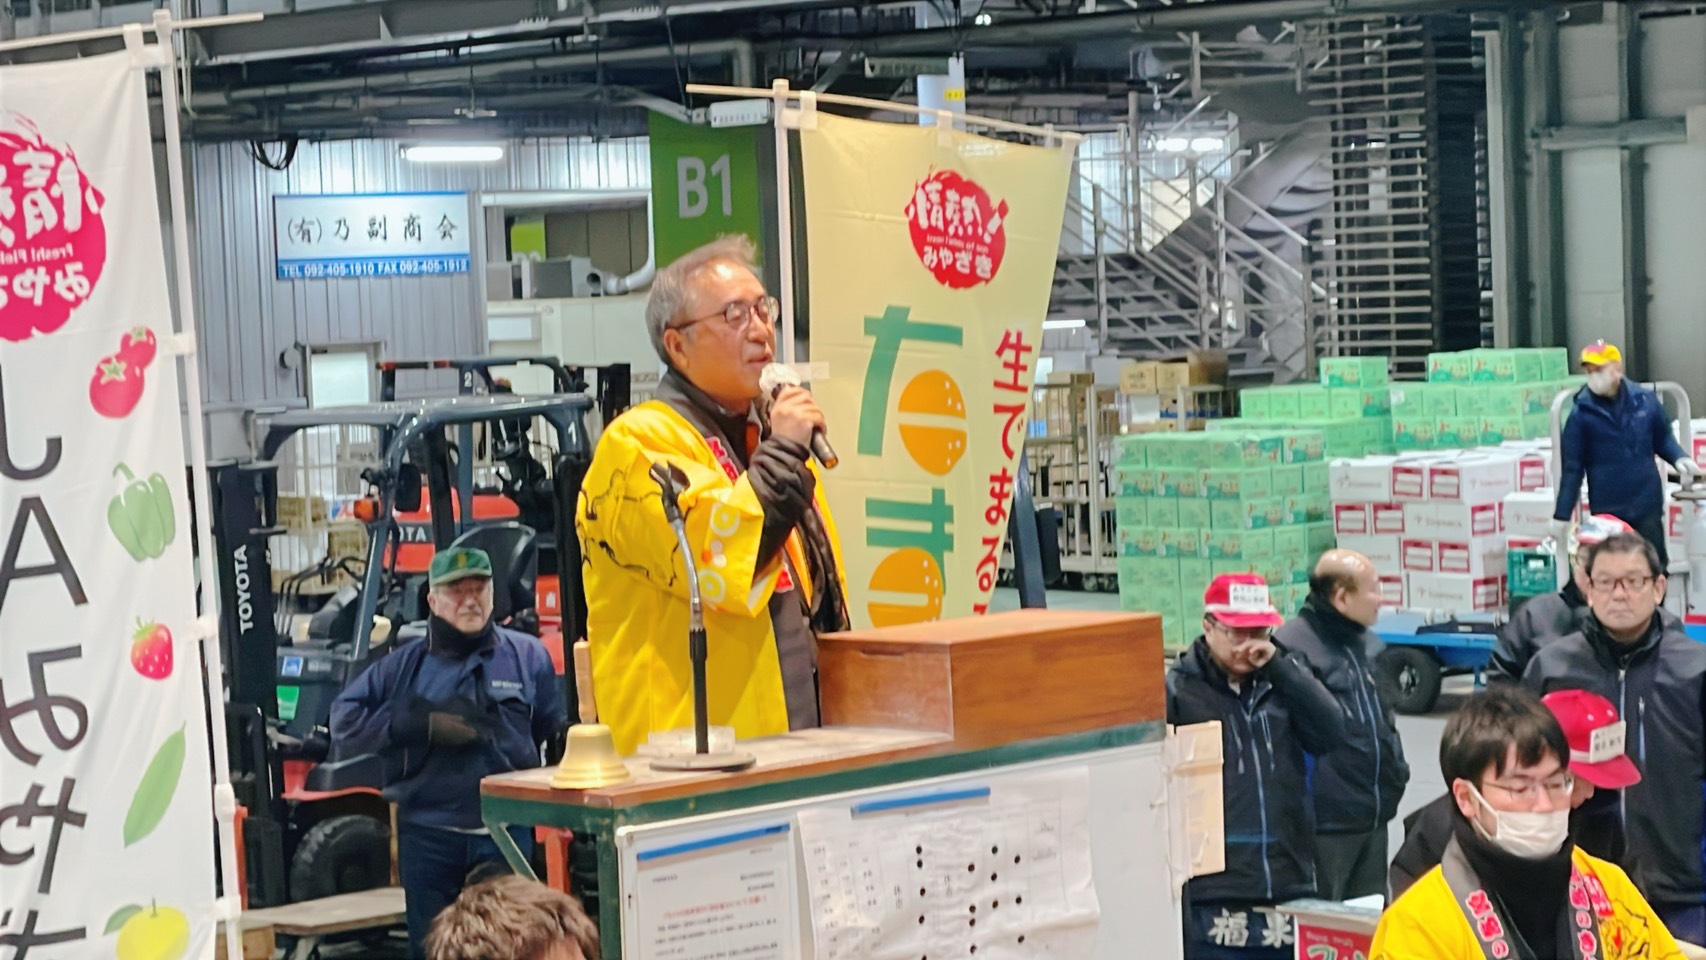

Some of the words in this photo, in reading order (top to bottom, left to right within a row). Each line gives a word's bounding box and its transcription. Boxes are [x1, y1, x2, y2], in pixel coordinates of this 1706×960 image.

[677, 153, 732, 219] B1
[282, 265, 302, 278] TEL
[377, 261, 398, 275] FAX
[922, 244, 993, 280] みやざき
[464, 371, 472, 388] 2
[567, 420, 577, 446] 1
[973, 329, 1033, 616] 生でまる
[233, 544, 254, 635] TOYOTA
